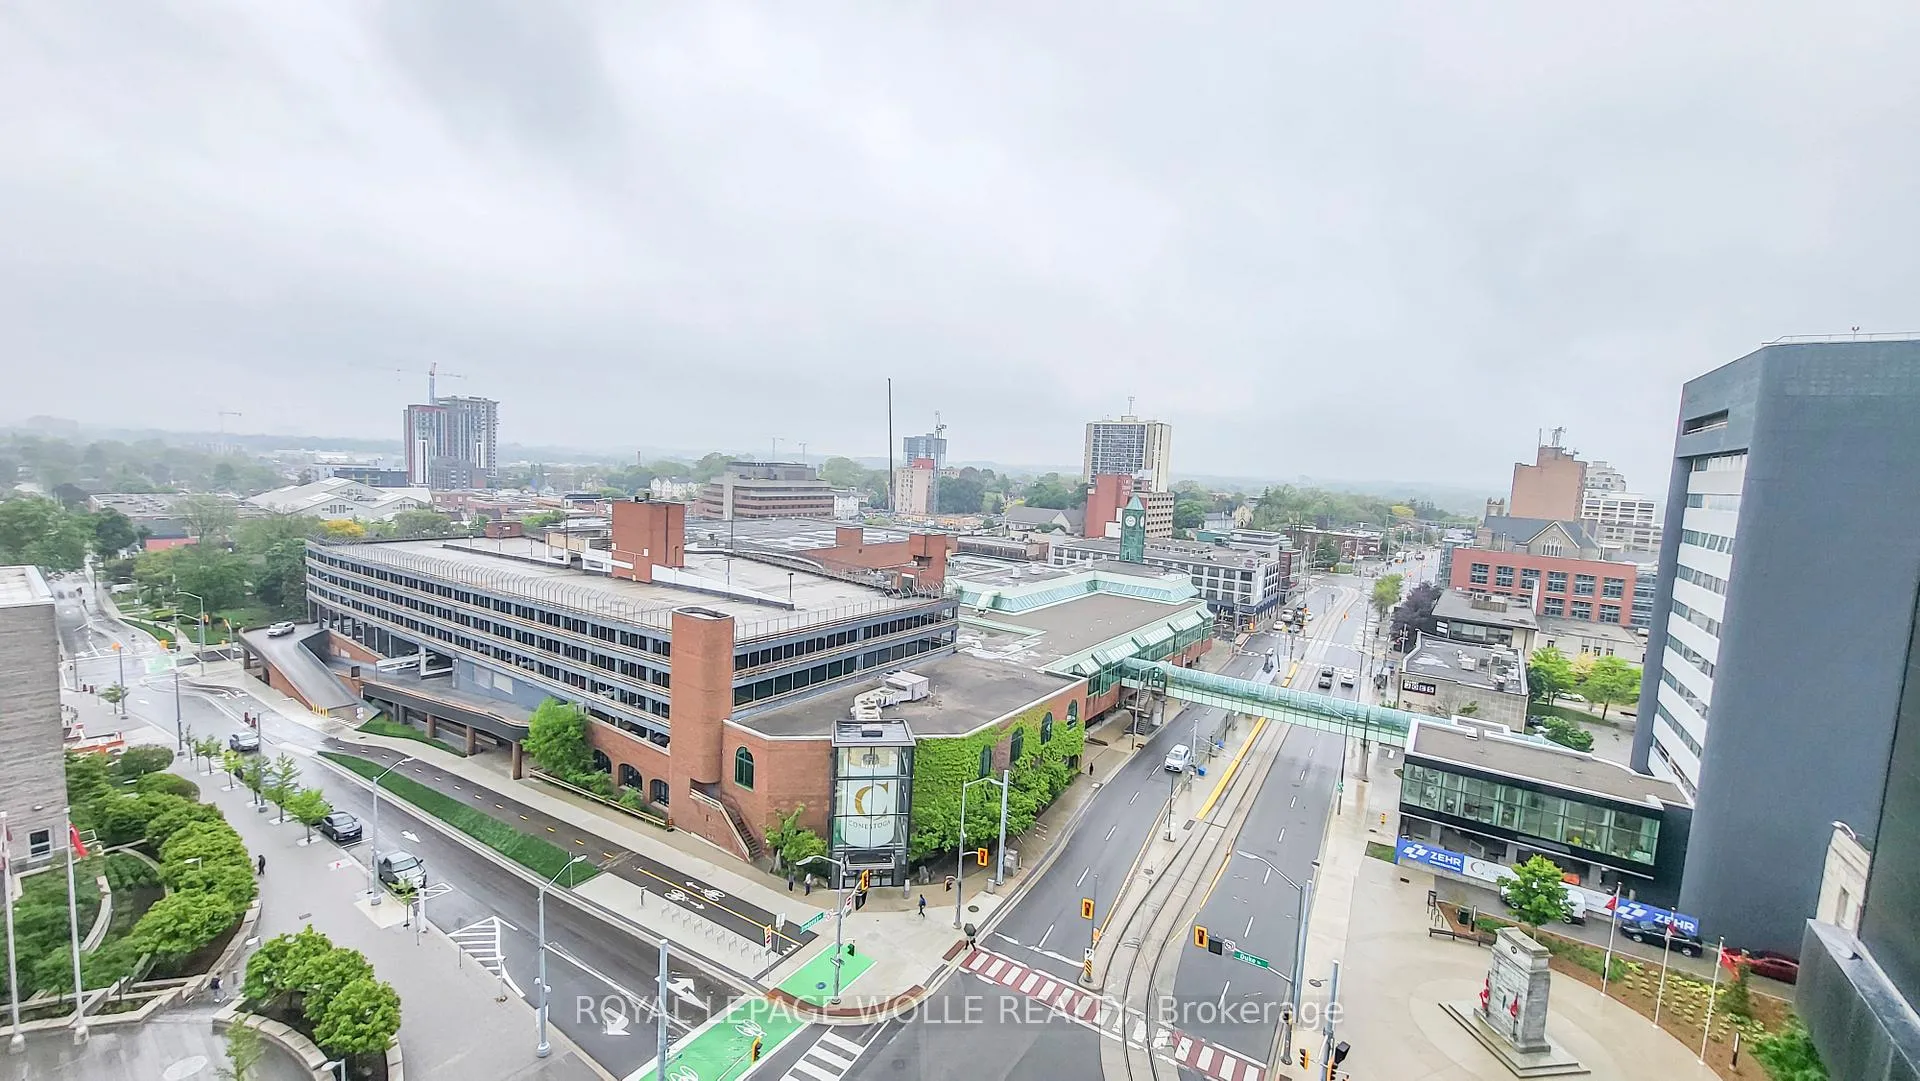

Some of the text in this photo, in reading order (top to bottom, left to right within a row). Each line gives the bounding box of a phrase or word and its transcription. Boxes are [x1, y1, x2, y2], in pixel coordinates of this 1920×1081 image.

[1430, 852, 1461, 867] ZEHR
[1654, 913, 1694, 932] ZEHR
[1240, 953, 1256, 964] Duke
